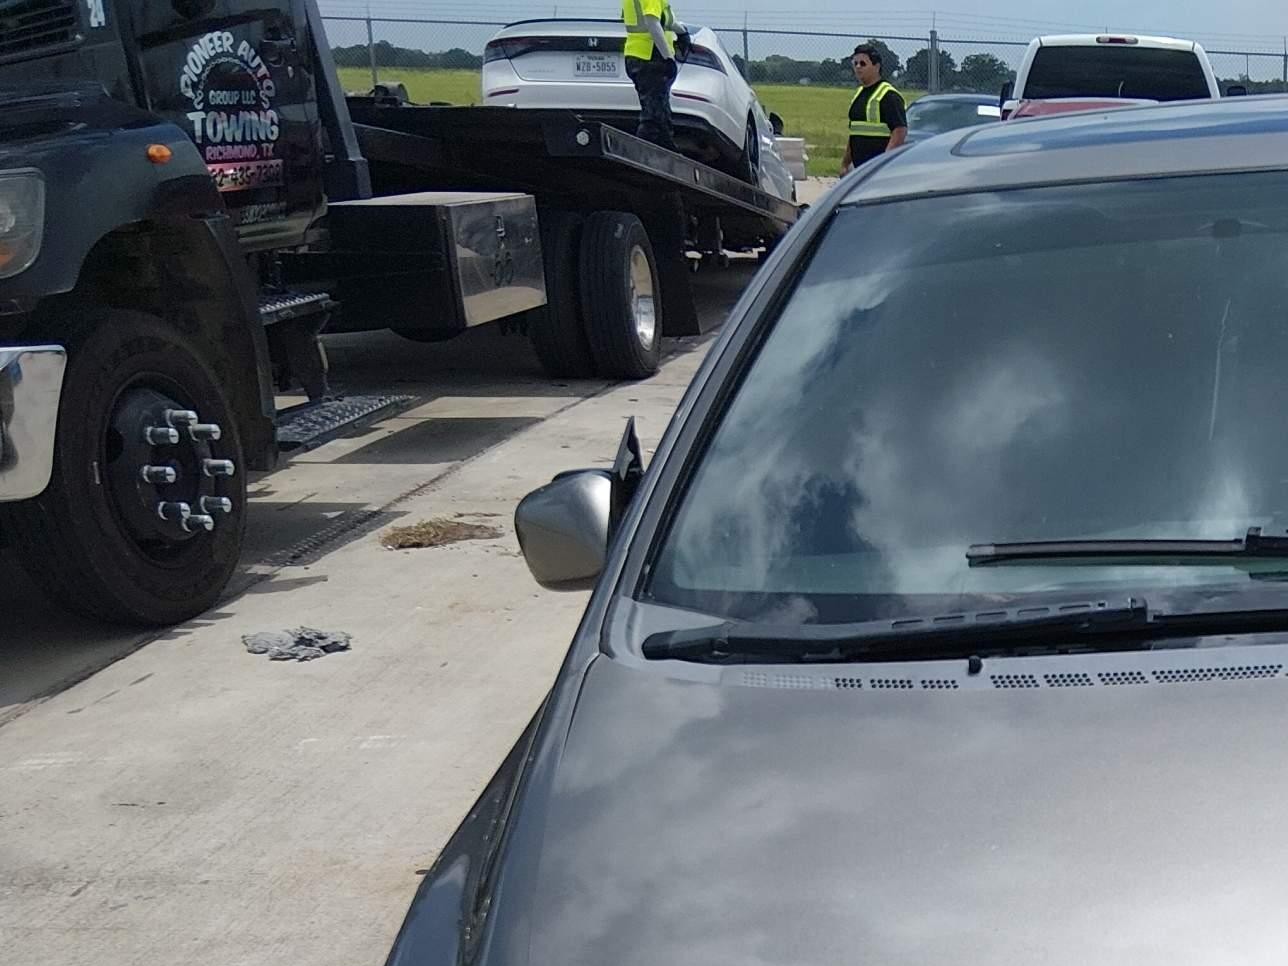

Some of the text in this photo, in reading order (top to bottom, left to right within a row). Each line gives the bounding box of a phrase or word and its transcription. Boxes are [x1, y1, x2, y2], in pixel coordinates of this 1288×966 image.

[180, 31, 235, 100] PIONEER
[208, 89, 257, 105] GROUP LLC
[186, 110, 279, 143] TOWING
[261, 143, 274, 158] TX
